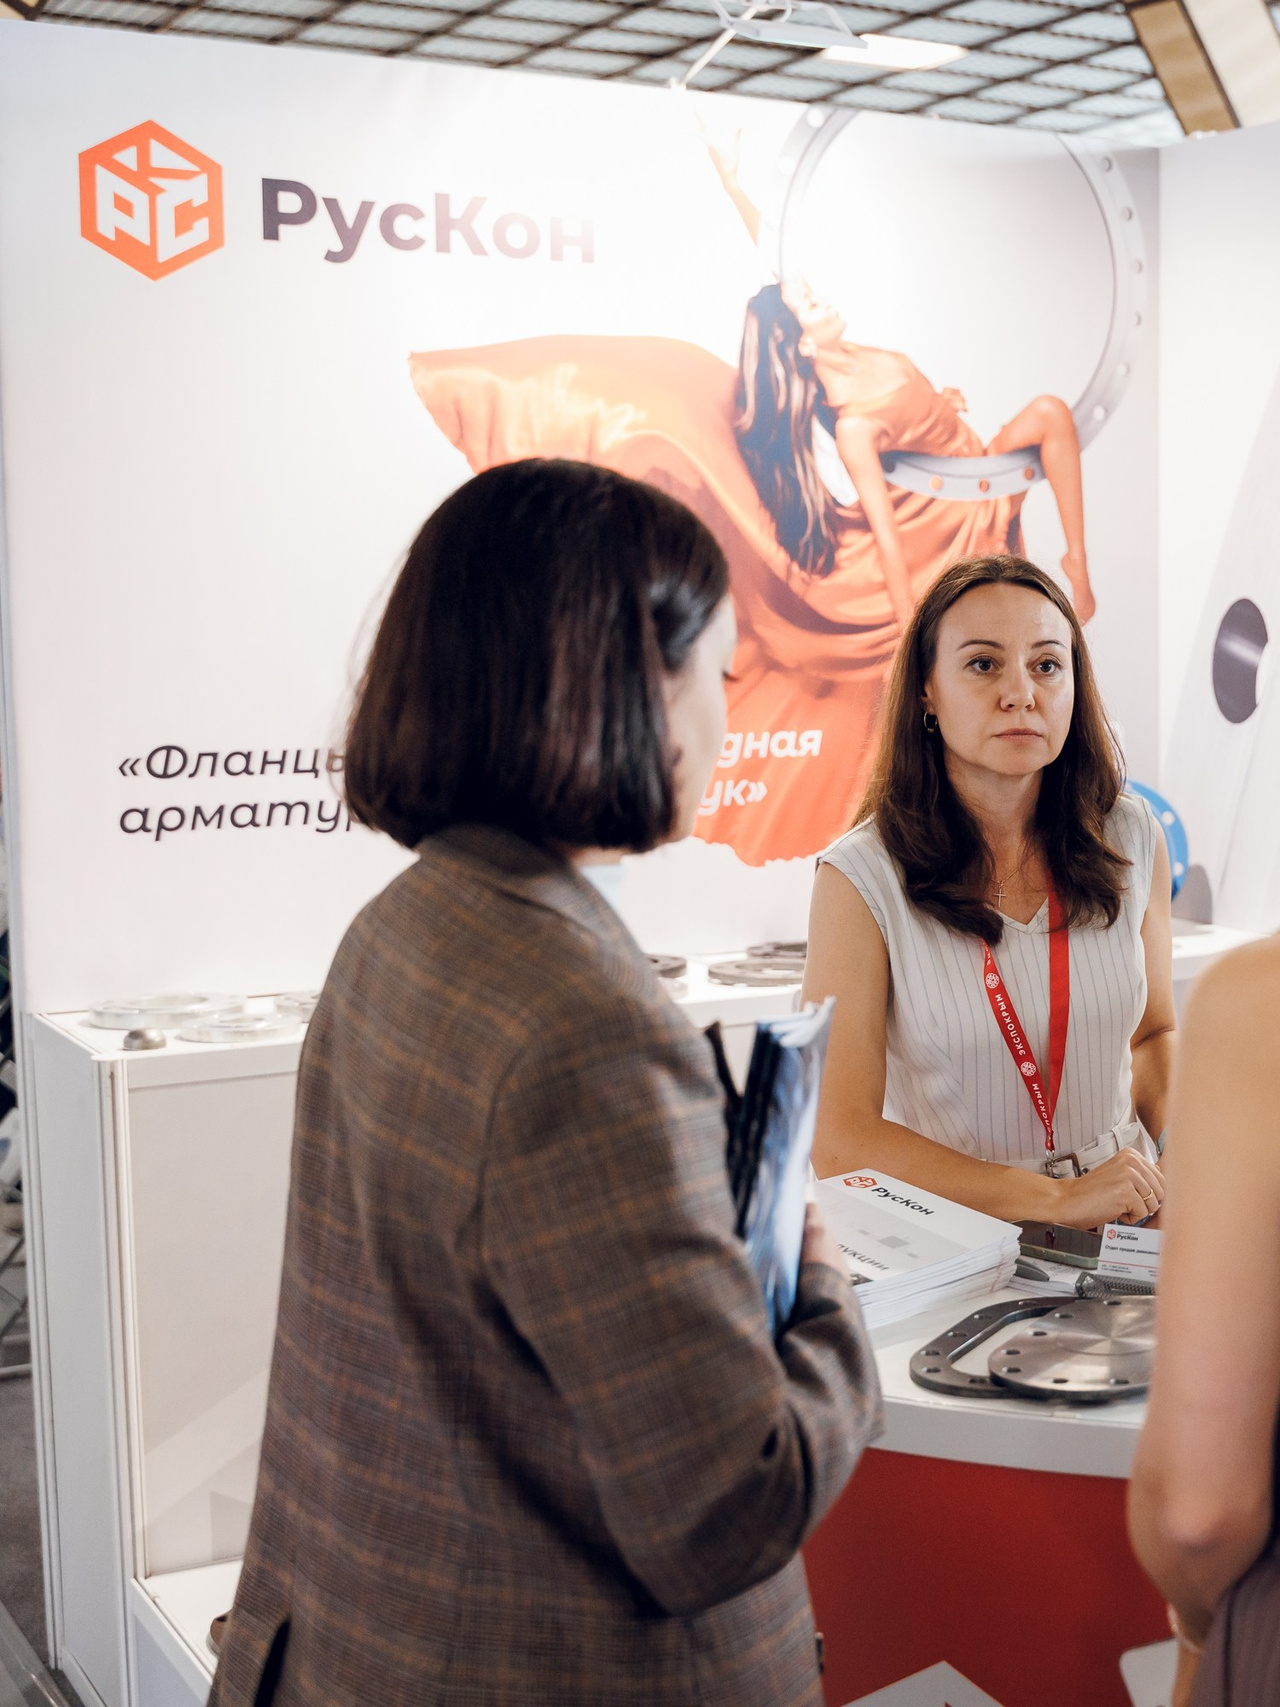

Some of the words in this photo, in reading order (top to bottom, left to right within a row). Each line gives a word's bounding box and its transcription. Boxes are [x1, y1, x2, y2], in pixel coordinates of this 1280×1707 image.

[261, 177, 595, 264] РусКон
[716, 729, 823, 769] дная
[119, 800, 351, 841] армату
[697, 779, 768, 816] ук»
[995, 993, 1026, 1056] ЭКСПОКРЫМ
[871, 1187, 934, 1215] РусКон
